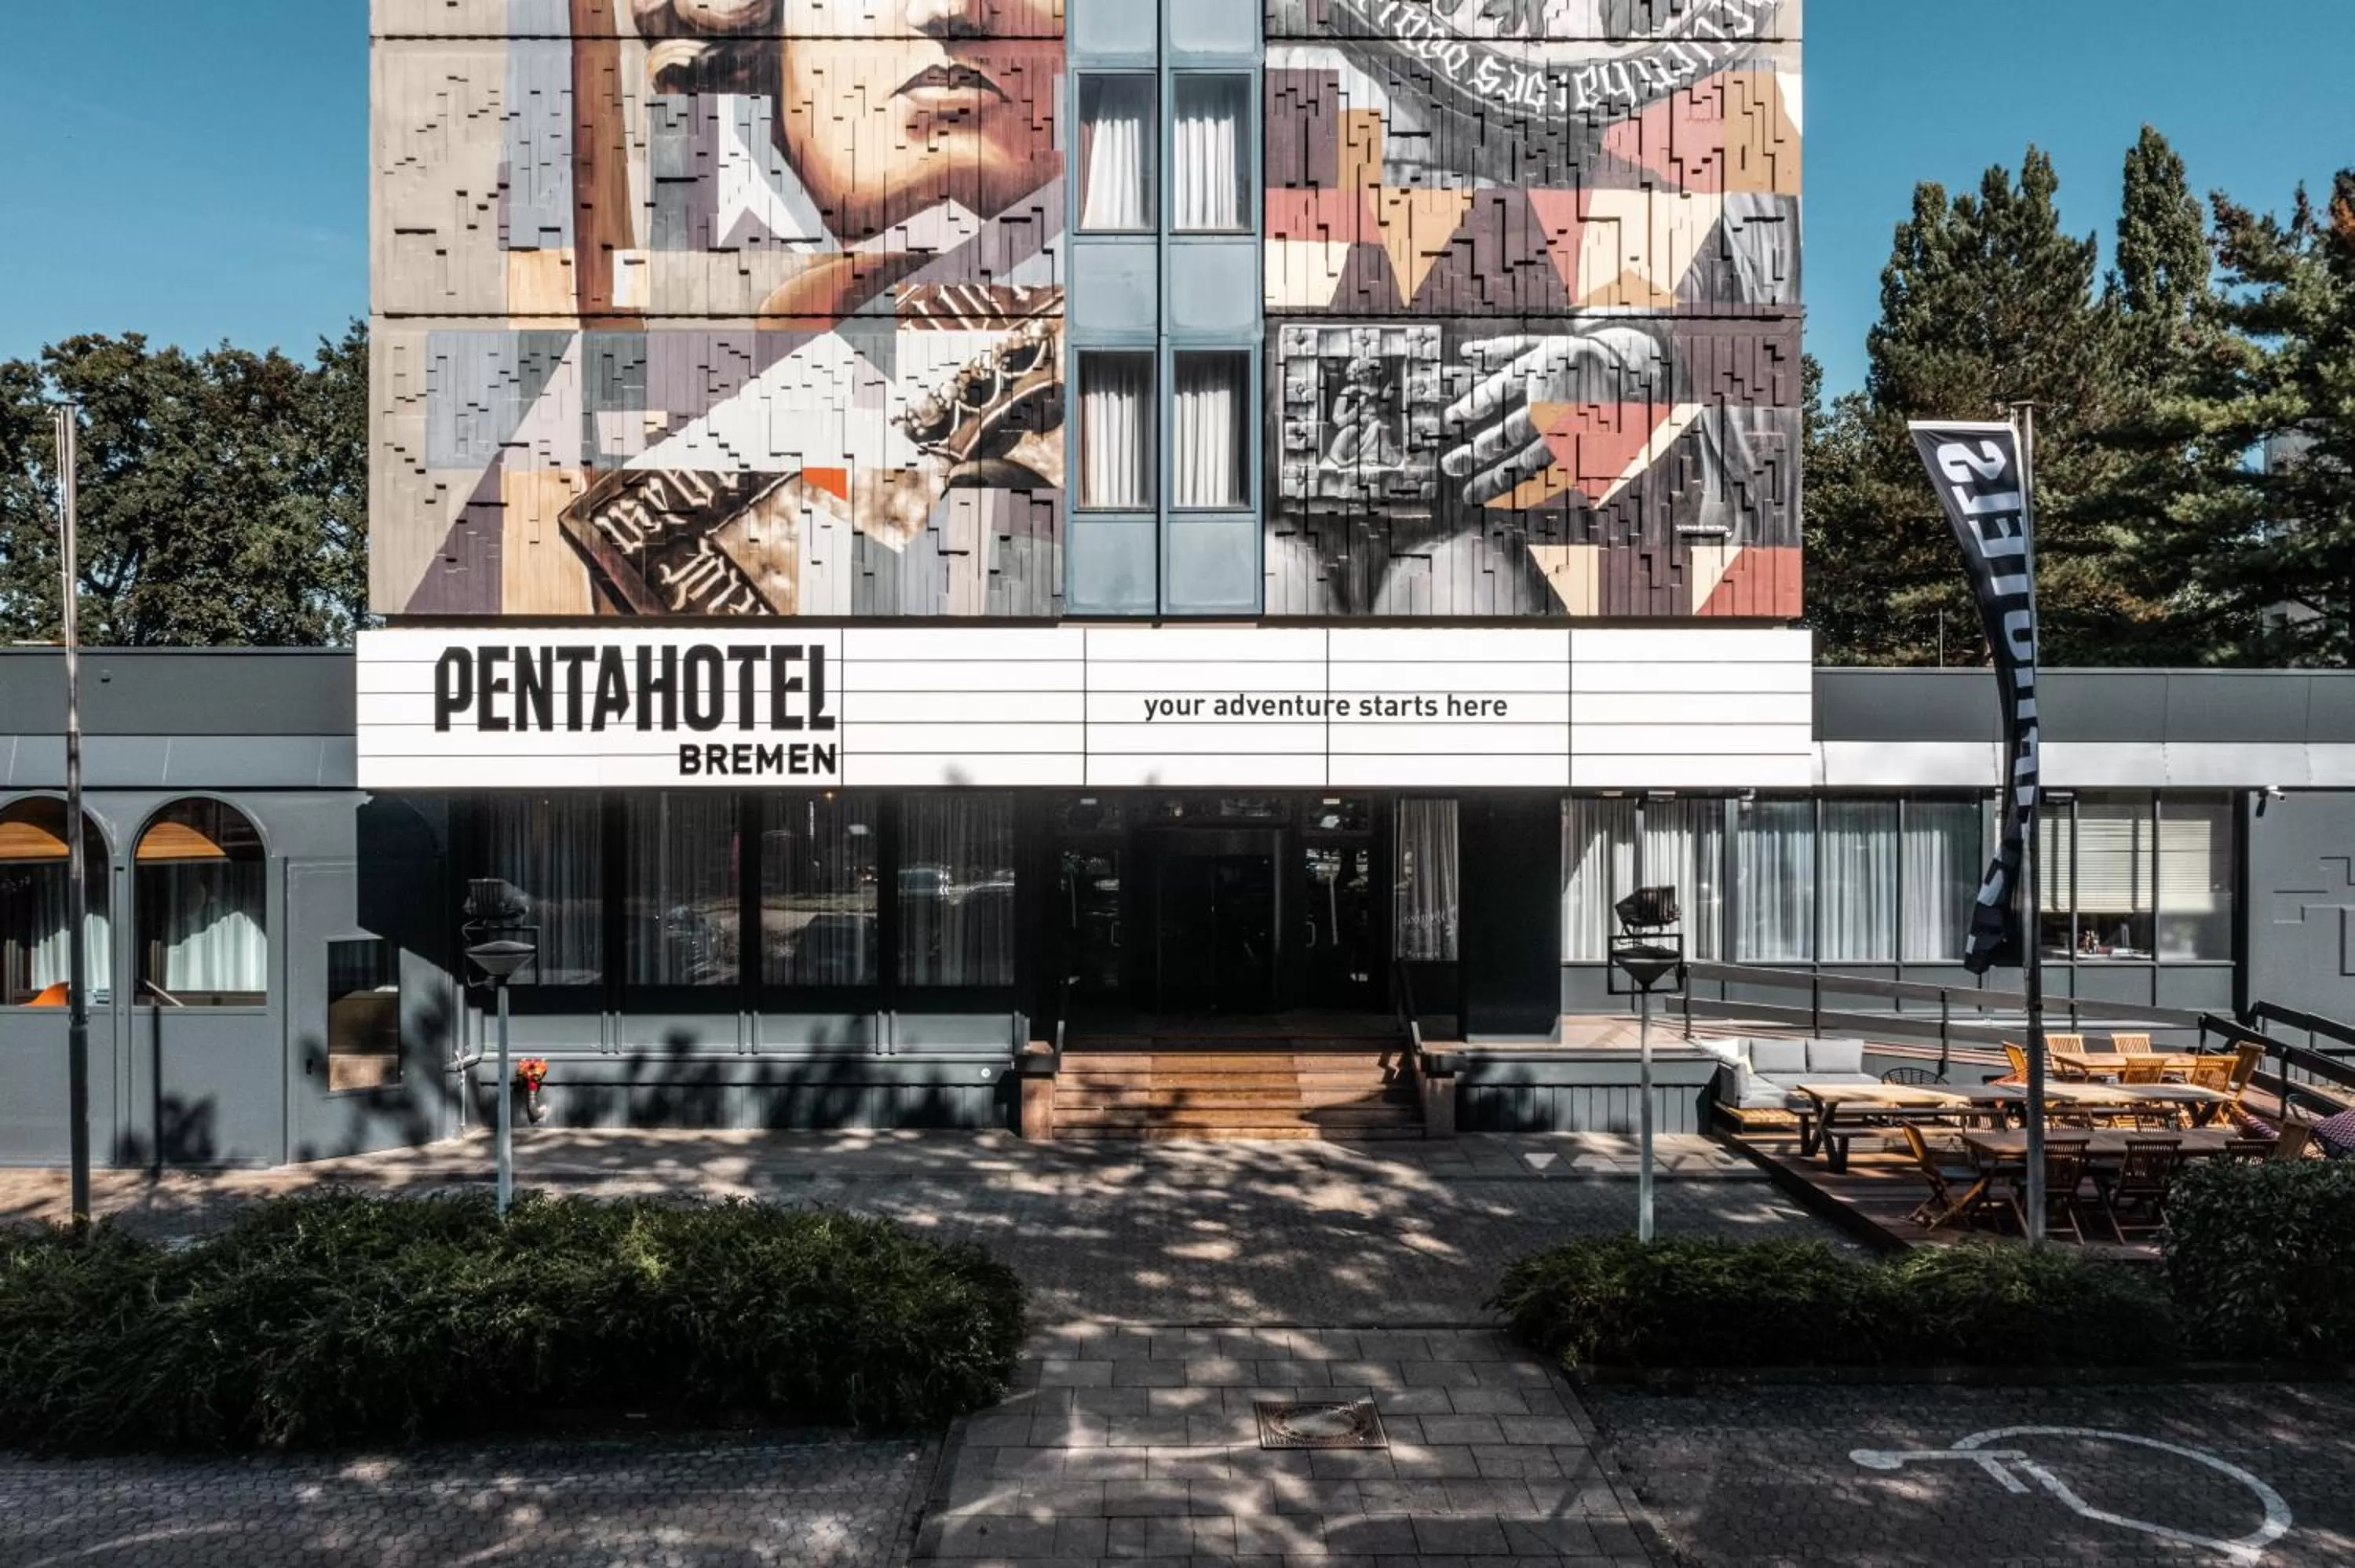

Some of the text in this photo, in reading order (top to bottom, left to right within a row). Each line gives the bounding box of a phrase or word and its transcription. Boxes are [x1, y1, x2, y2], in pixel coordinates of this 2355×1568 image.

[434, 643, 836, 731] PENTAHOTEL
[1144, 693, 1508, 723] your adventure starts here
[679, 743, 837, 775] BREMEN
